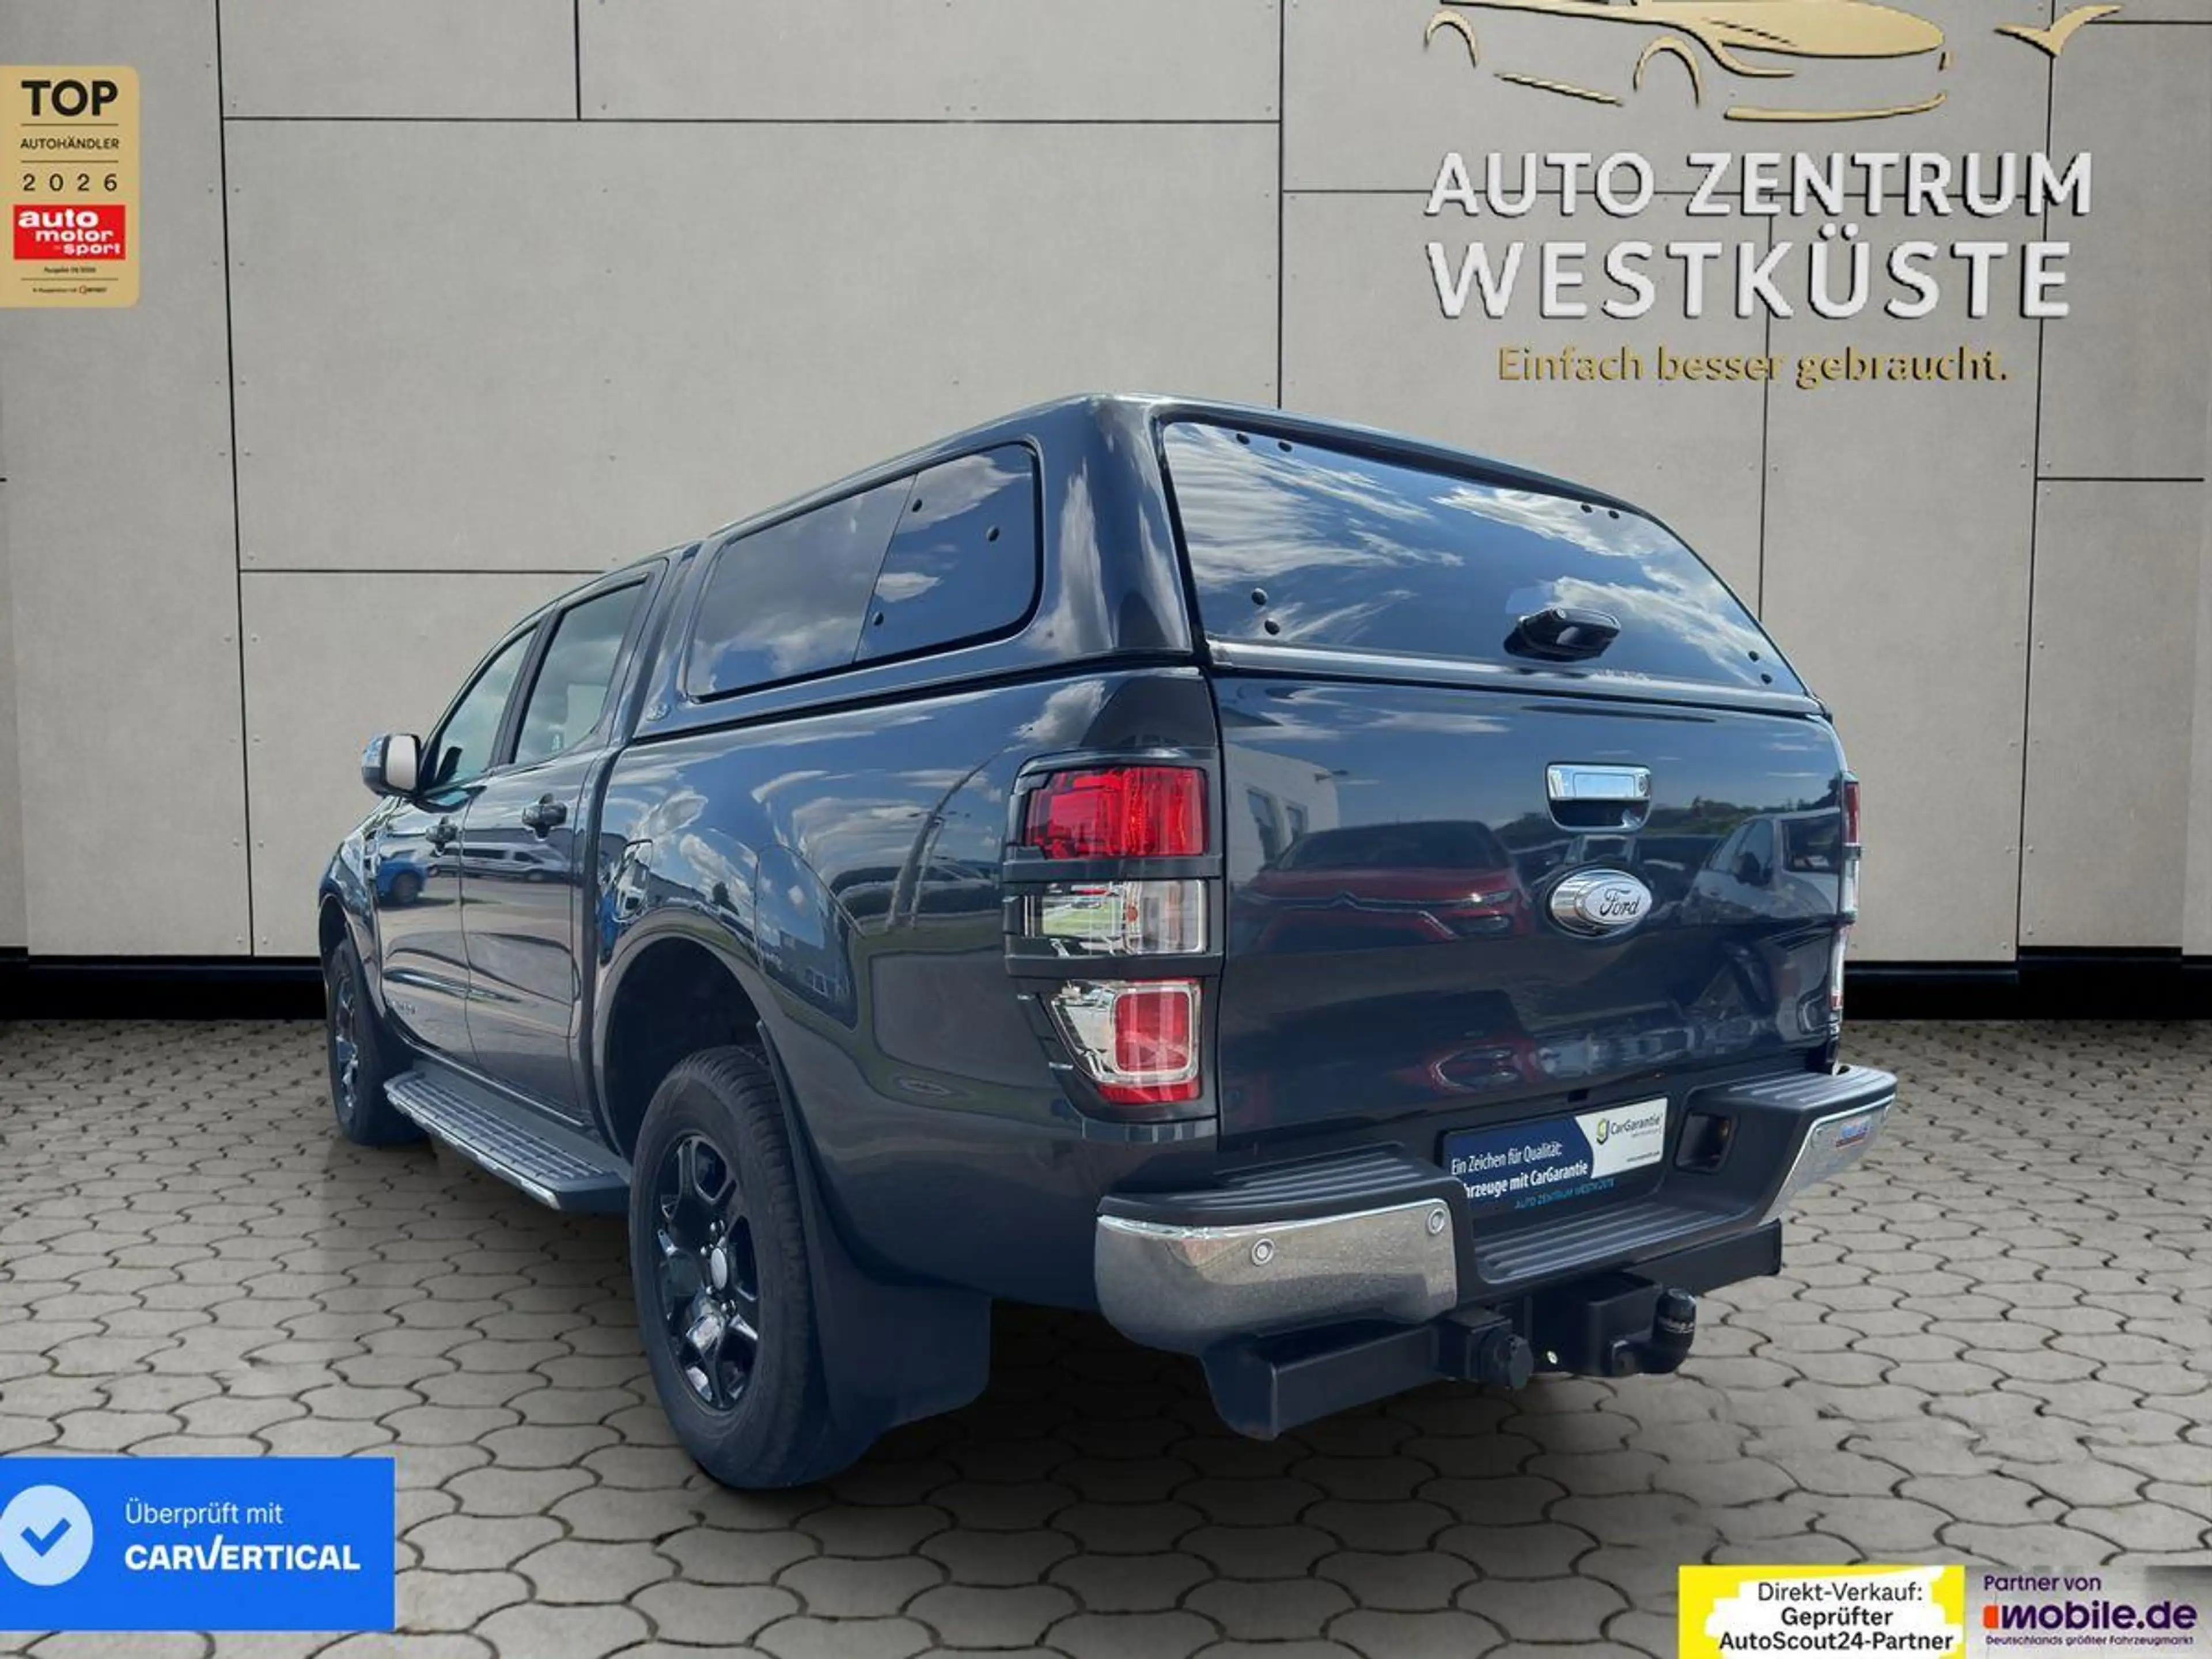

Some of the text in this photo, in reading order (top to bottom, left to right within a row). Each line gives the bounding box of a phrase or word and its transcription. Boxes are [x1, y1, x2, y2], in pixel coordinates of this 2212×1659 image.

[1425, 152, 2093, 217] AUTO ZENTRUM
[1425, 223, 2070, 318] WESTKÜSTE
[1499, 347, 2009, 389] Einfach besser gebraucht.
[1600, 888, 1641, 916] Ford
[1451, 1140, 1563, 1175] Ein Zeichen für Qualität:
[1509, 1171, 1529, 1191] mit
[1530, 1160, 1588, 1186] CarGarantie
